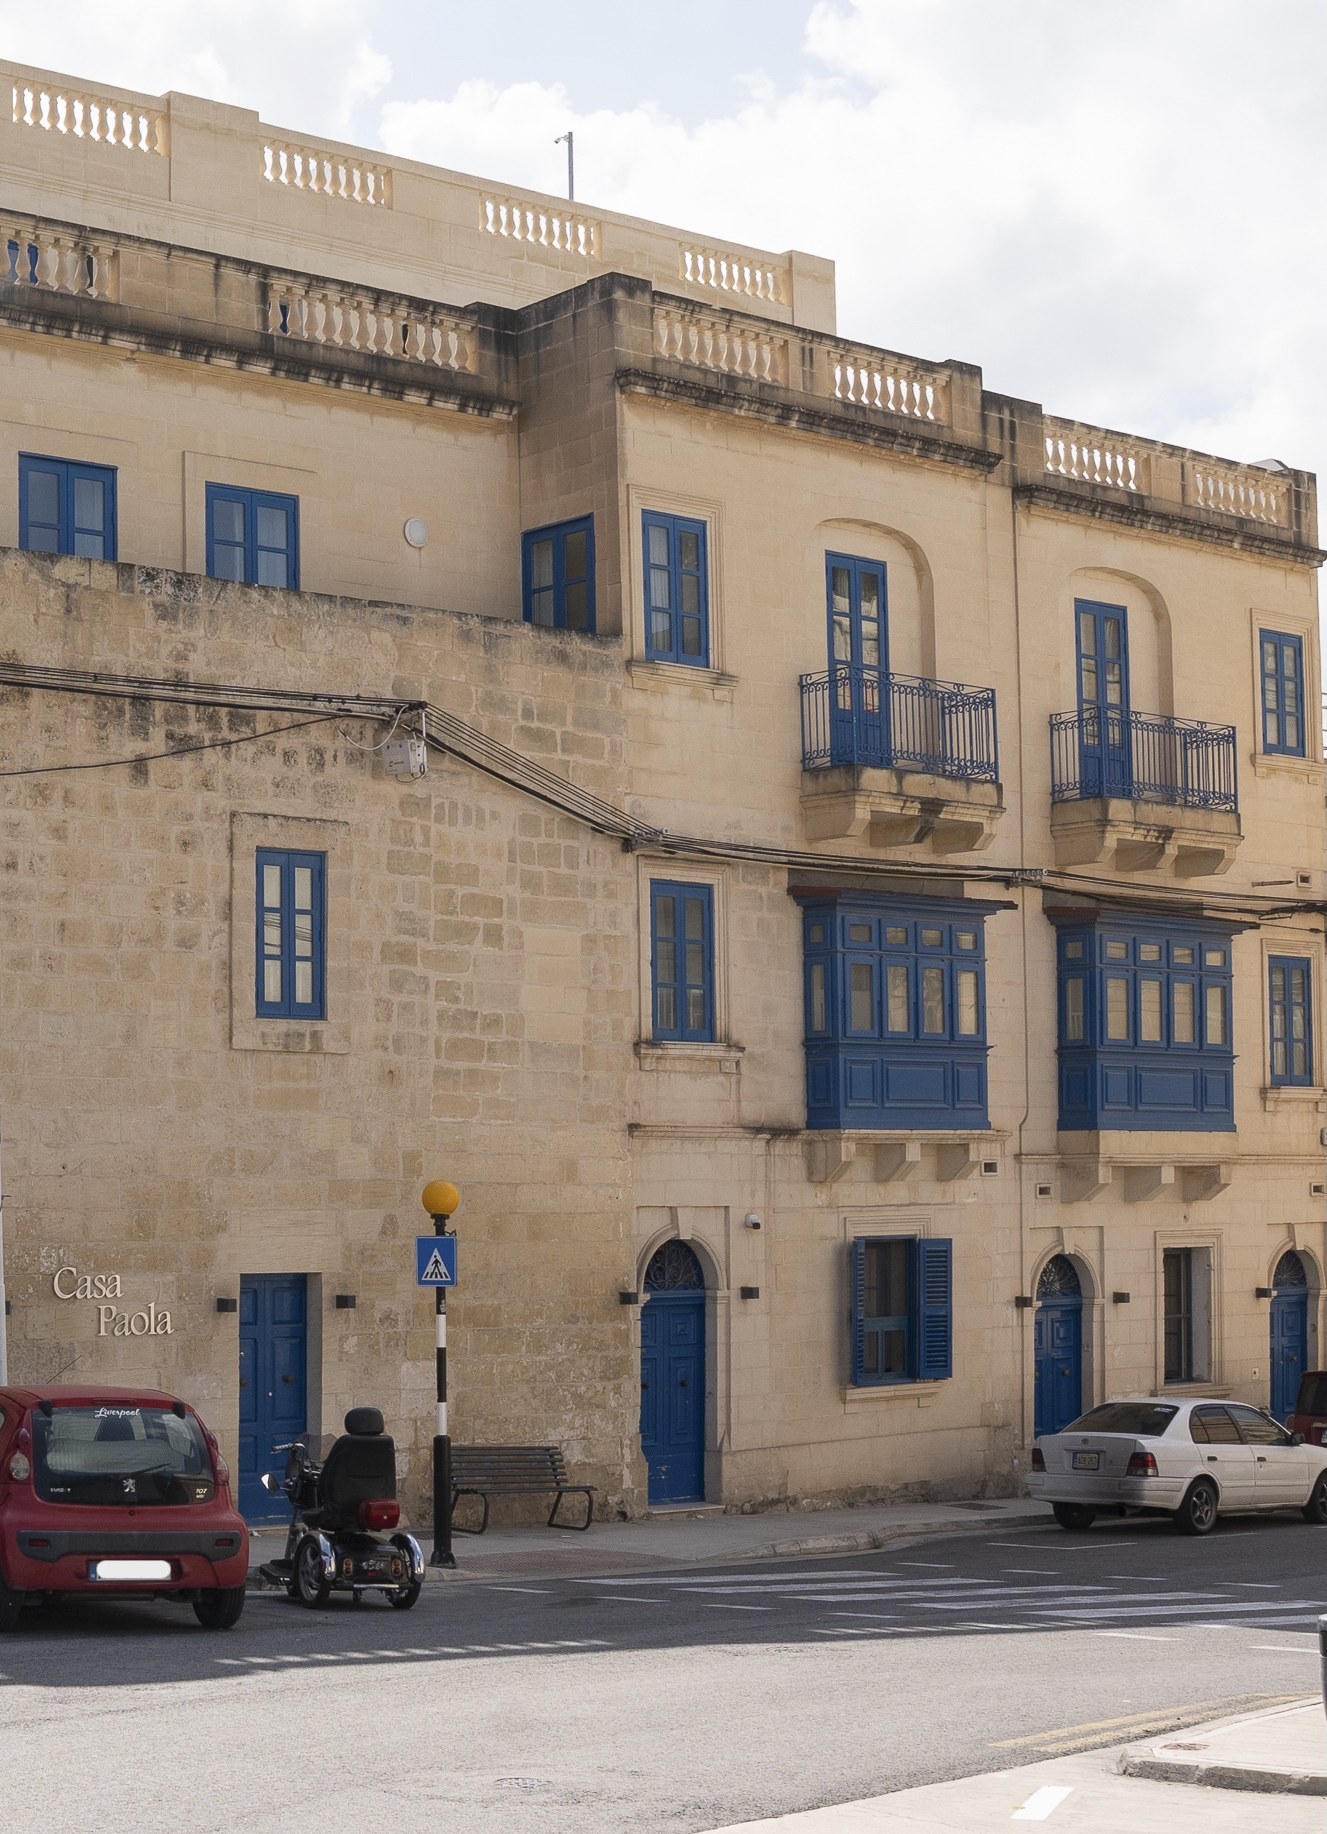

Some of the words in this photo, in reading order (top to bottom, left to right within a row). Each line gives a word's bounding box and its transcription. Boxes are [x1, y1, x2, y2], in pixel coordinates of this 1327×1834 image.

[53, 1267, 124, 1299] Casa
[97, 1302, 174, 1336] Paola
[94, 1407, 140, 1418] Liverpool
